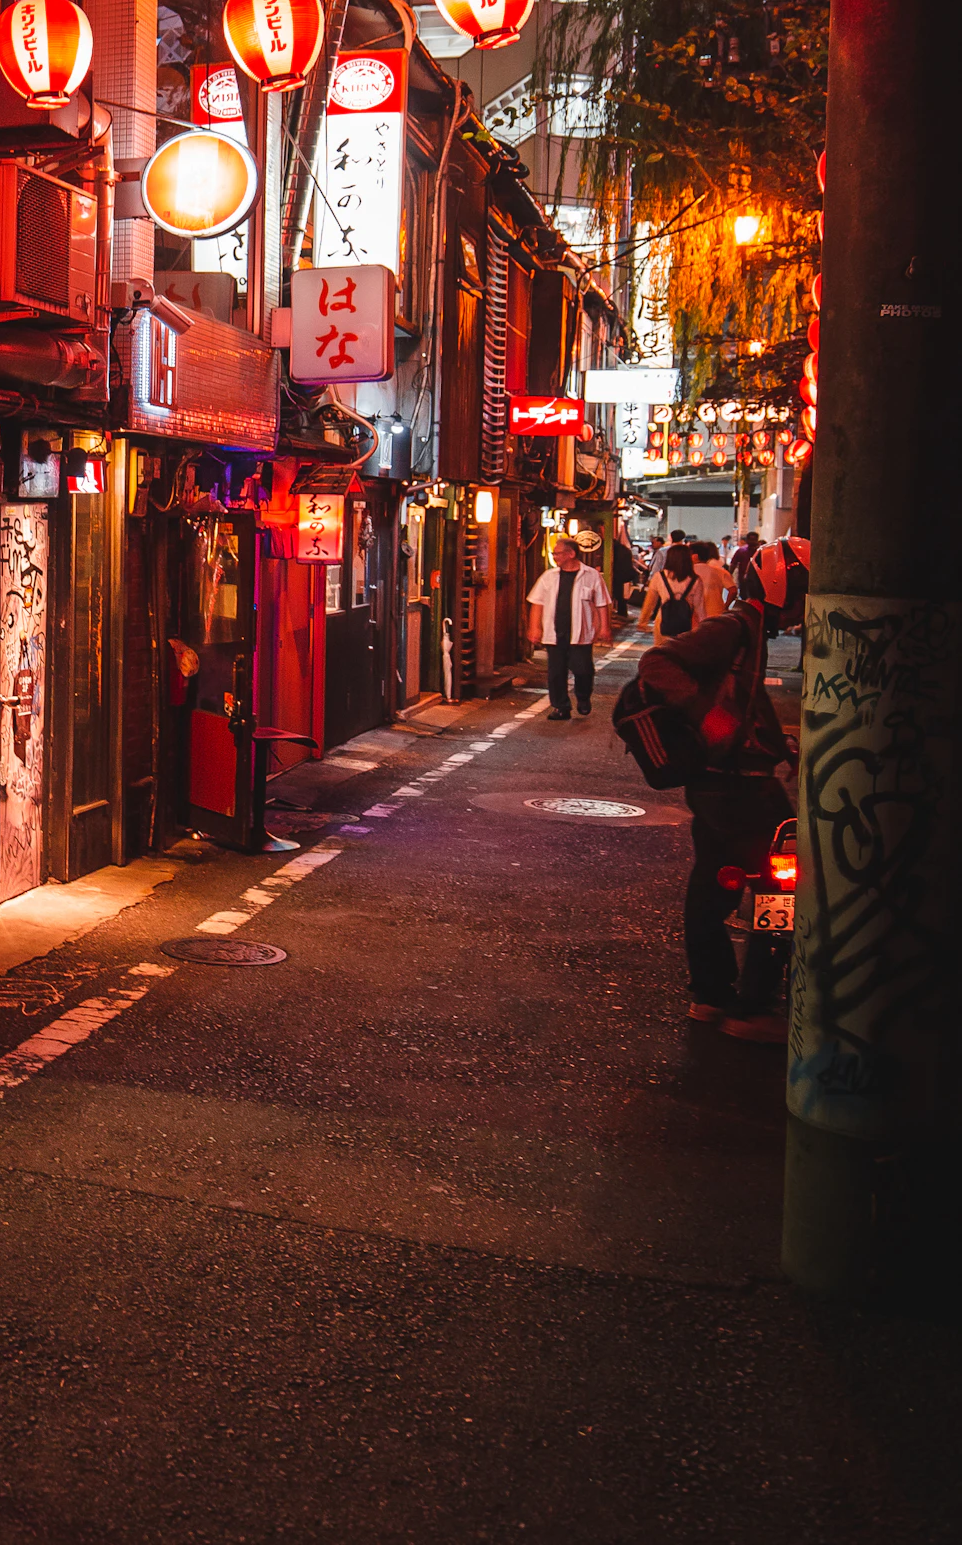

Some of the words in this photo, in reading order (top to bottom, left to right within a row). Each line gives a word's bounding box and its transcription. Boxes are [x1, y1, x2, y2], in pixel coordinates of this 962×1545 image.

[20, 3, 44, 74] キリンビール
[341, 82, 380, 93] KIRIN
[374, 121, 391, 190] やきとり
[315, 276, 360, 370] はな
[757, 909, 795, 929] 63
